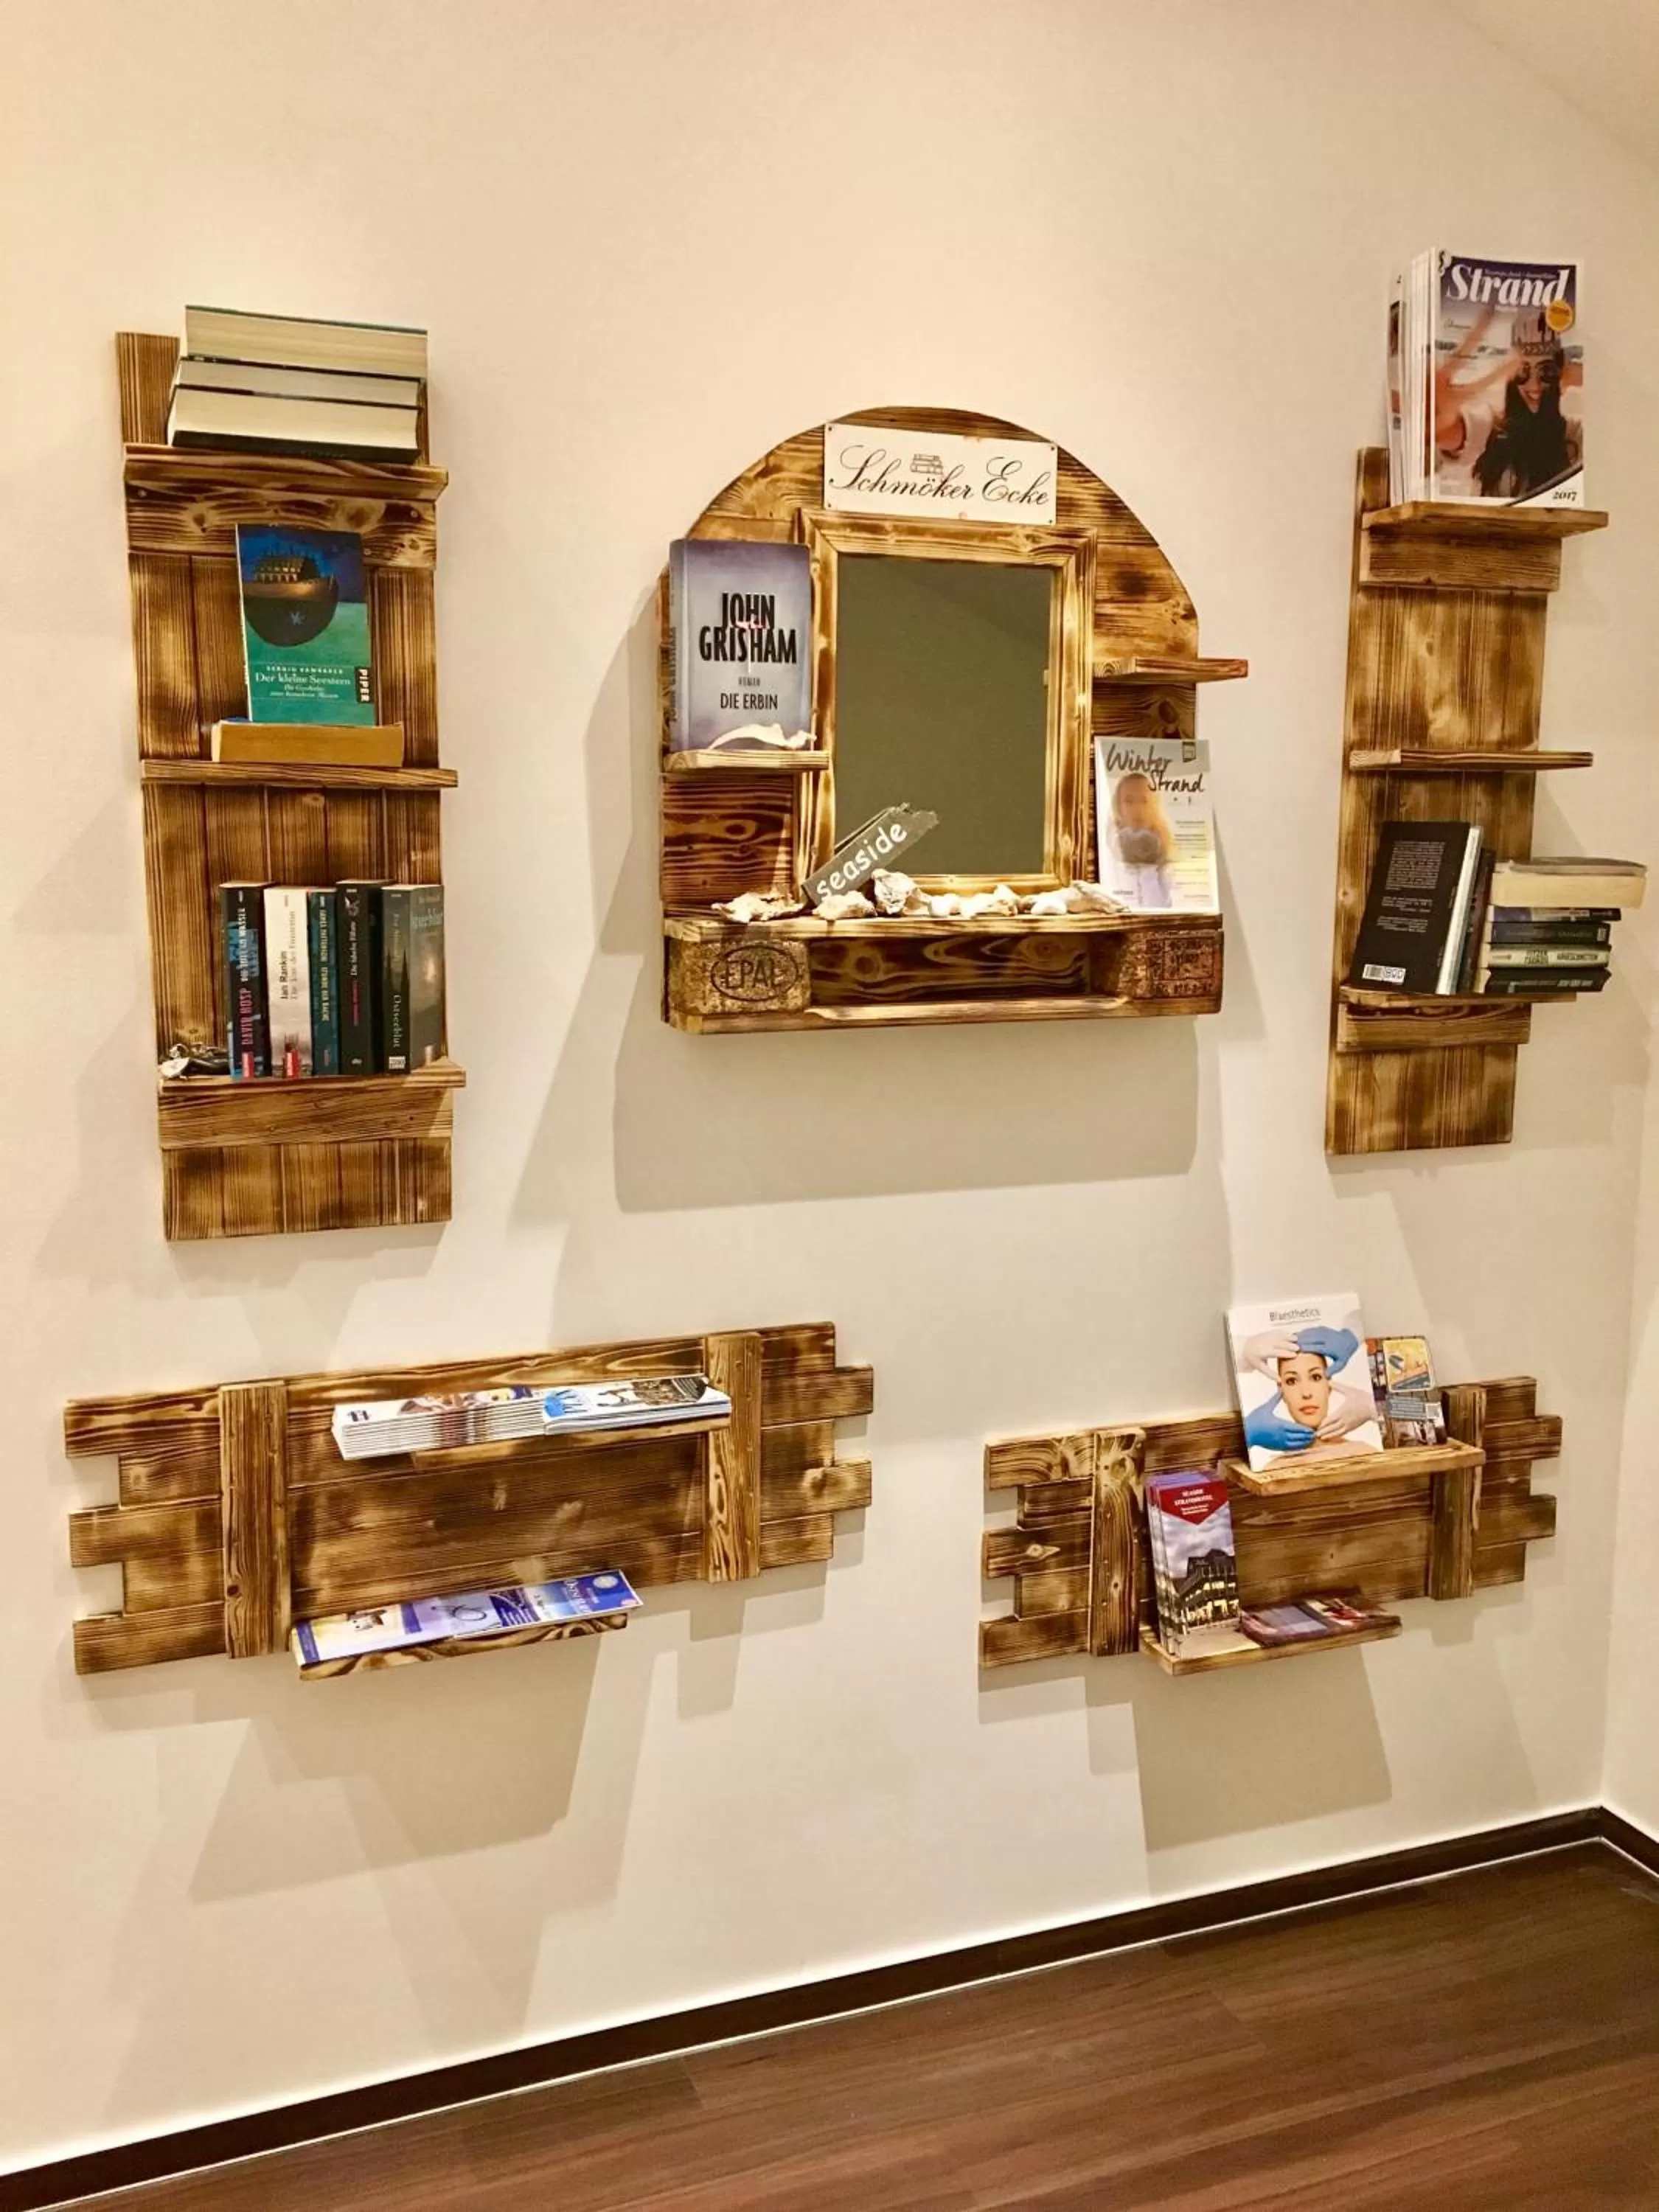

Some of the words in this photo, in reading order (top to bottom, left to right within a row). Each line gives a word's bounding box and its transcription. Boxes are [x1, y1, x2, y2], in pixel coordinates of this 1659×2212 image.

[1446, 263, 1570, 307] Strand
[829, 445, 973, 500] Schmöker
[981, 456, 1051, 505] Ecke
[721, 592, 775, 629] JOHN
[699, 625, 796, 664] GRISHAM
[255, 672, 277, 683] Der
[278, 672, 308, 684] kleine
[309, 674, 351, 685] Seestern
[358, 669, 370, 702] PIPER
[720, 692, 740, 709] DIE
[743, 694, 778, 710] ERBIN
[1107, 743, 1172, 773] Winter
[1149, 769, 1205, 793] Strand
[816, 824, 908, 900] seaside
[279, 951, 288, 983] Rankin
[280, 985, 288, 1000] Ian
[392, 994, 402, 1048] Ostseeblut
